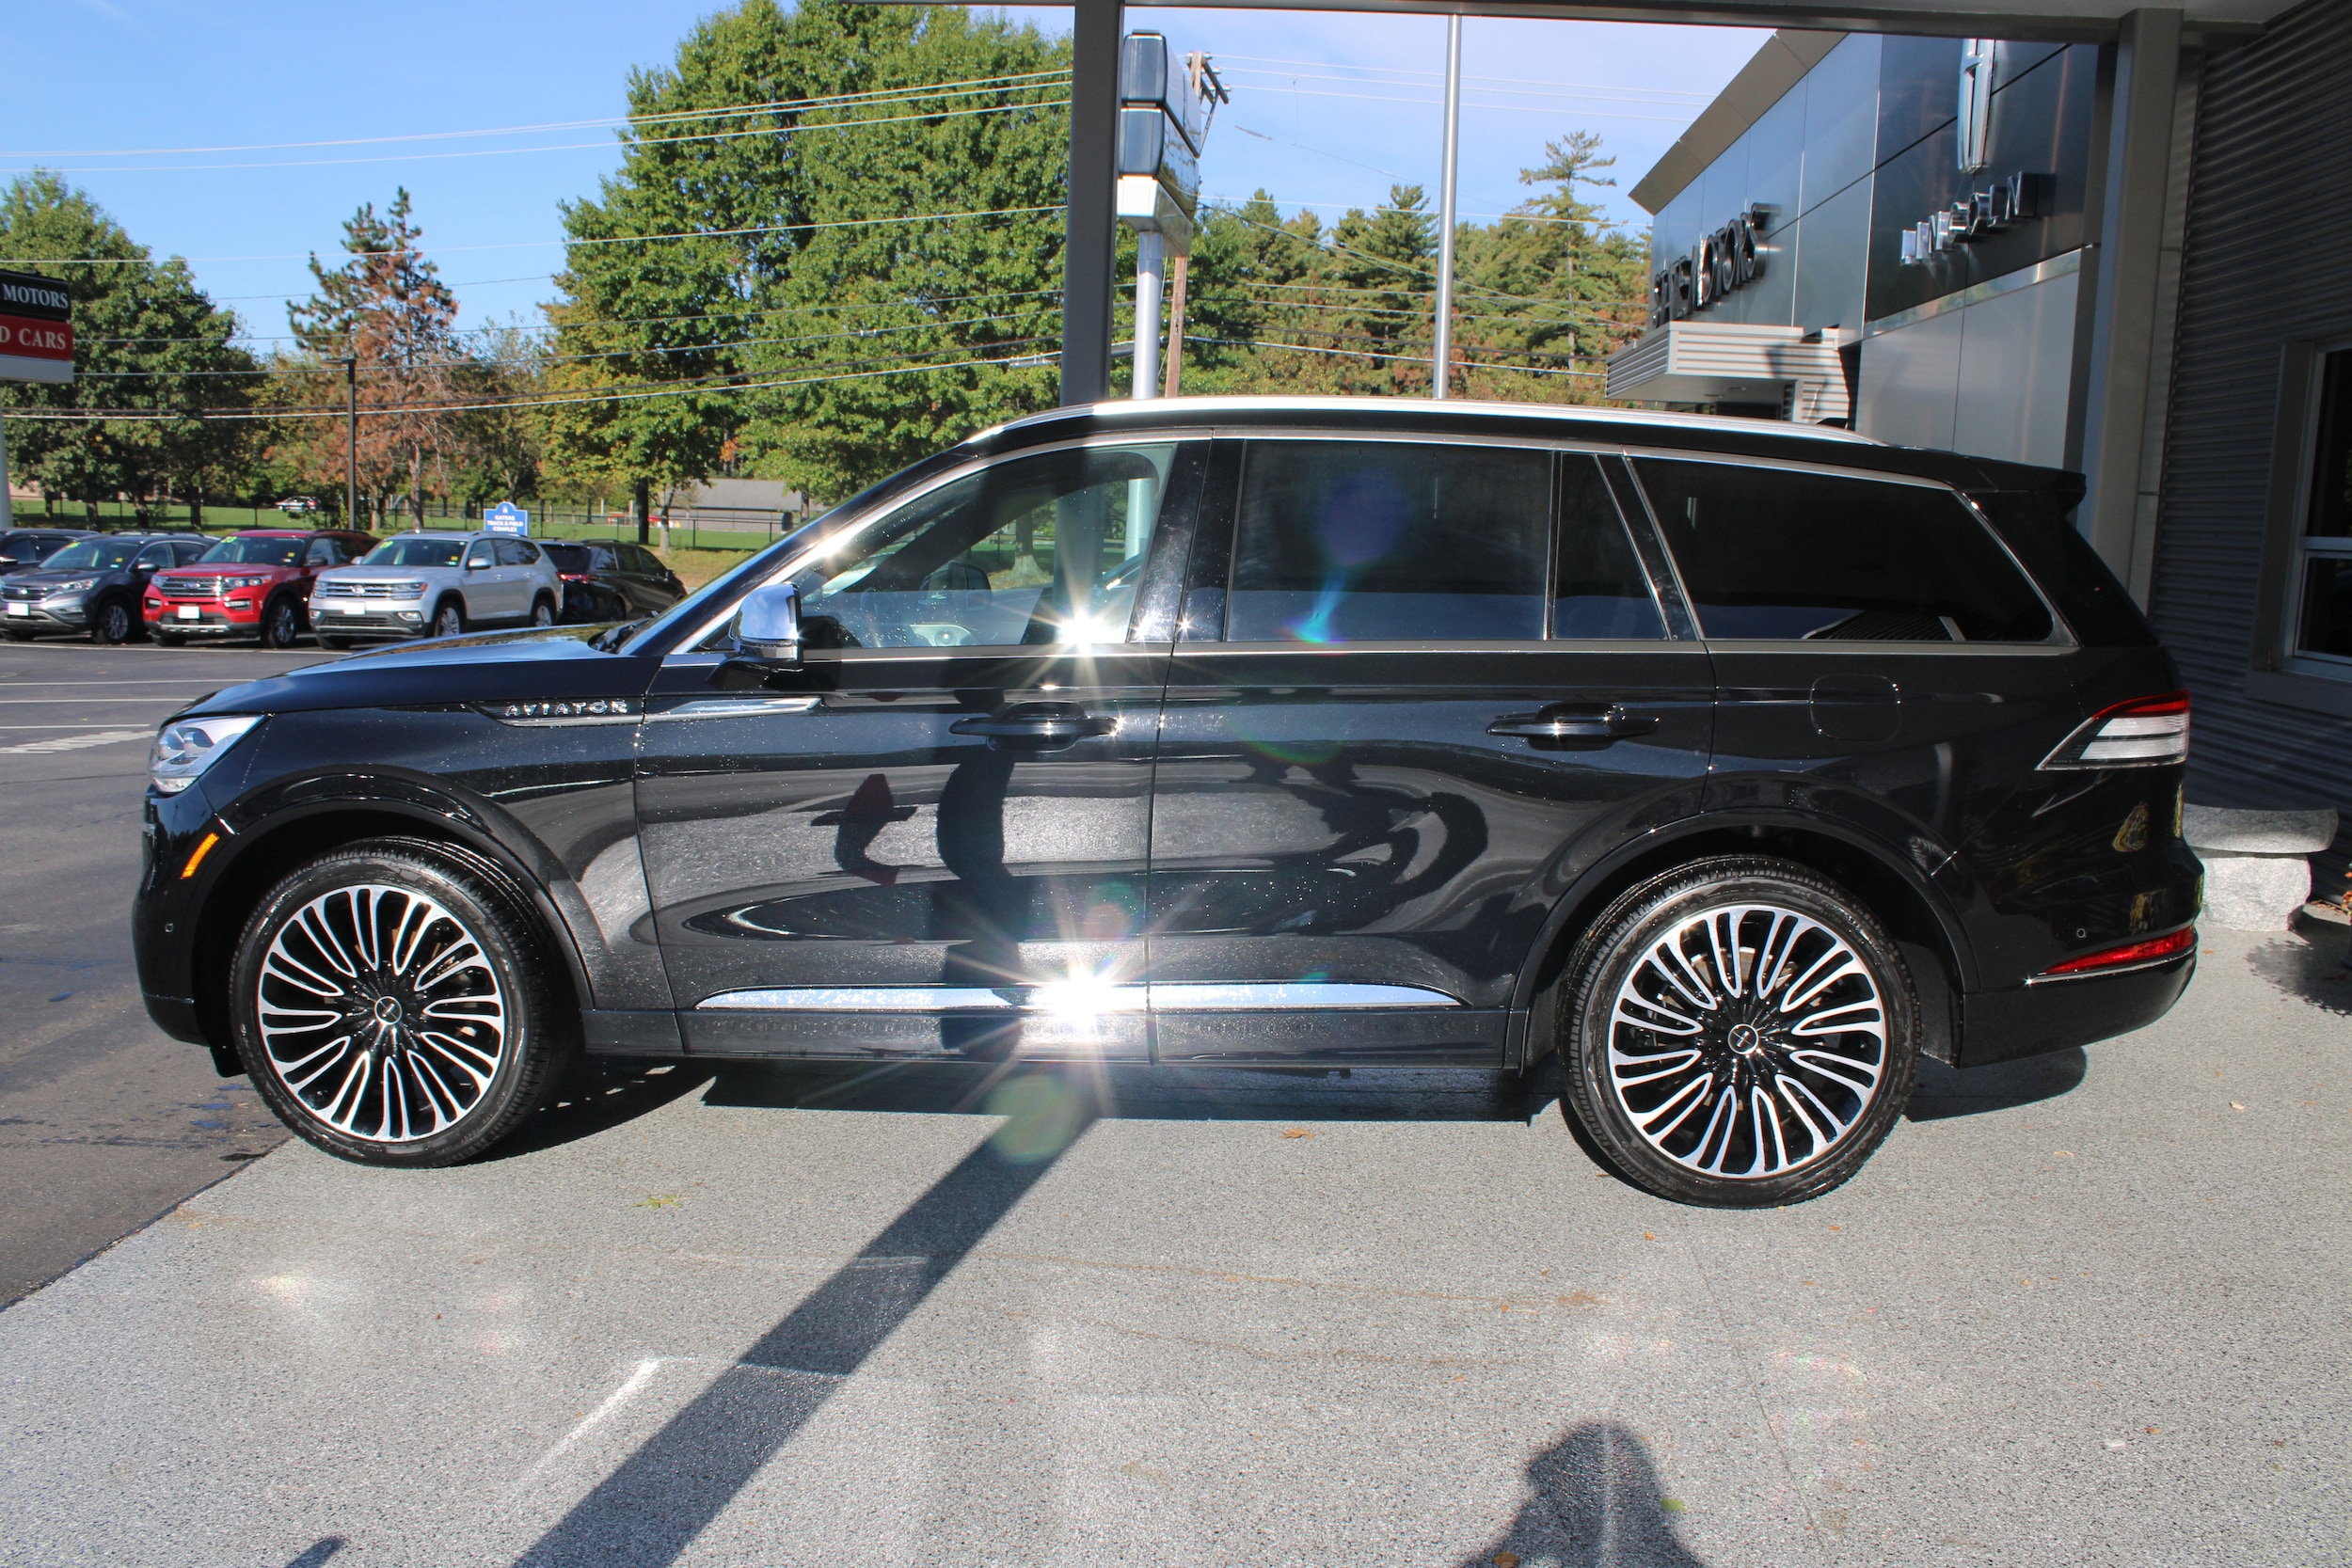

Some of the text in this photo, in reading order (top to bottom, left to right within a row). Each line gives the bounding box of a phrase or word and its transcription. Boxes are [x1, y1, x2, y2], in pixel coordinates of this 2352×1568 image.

[1899, 170, 2040, 265] LINCOLN
[2, 283, 69, 309] MOTORS
[19, 327, 67, 350] CARS
[505, 700, 628, 717] AVIATOR
